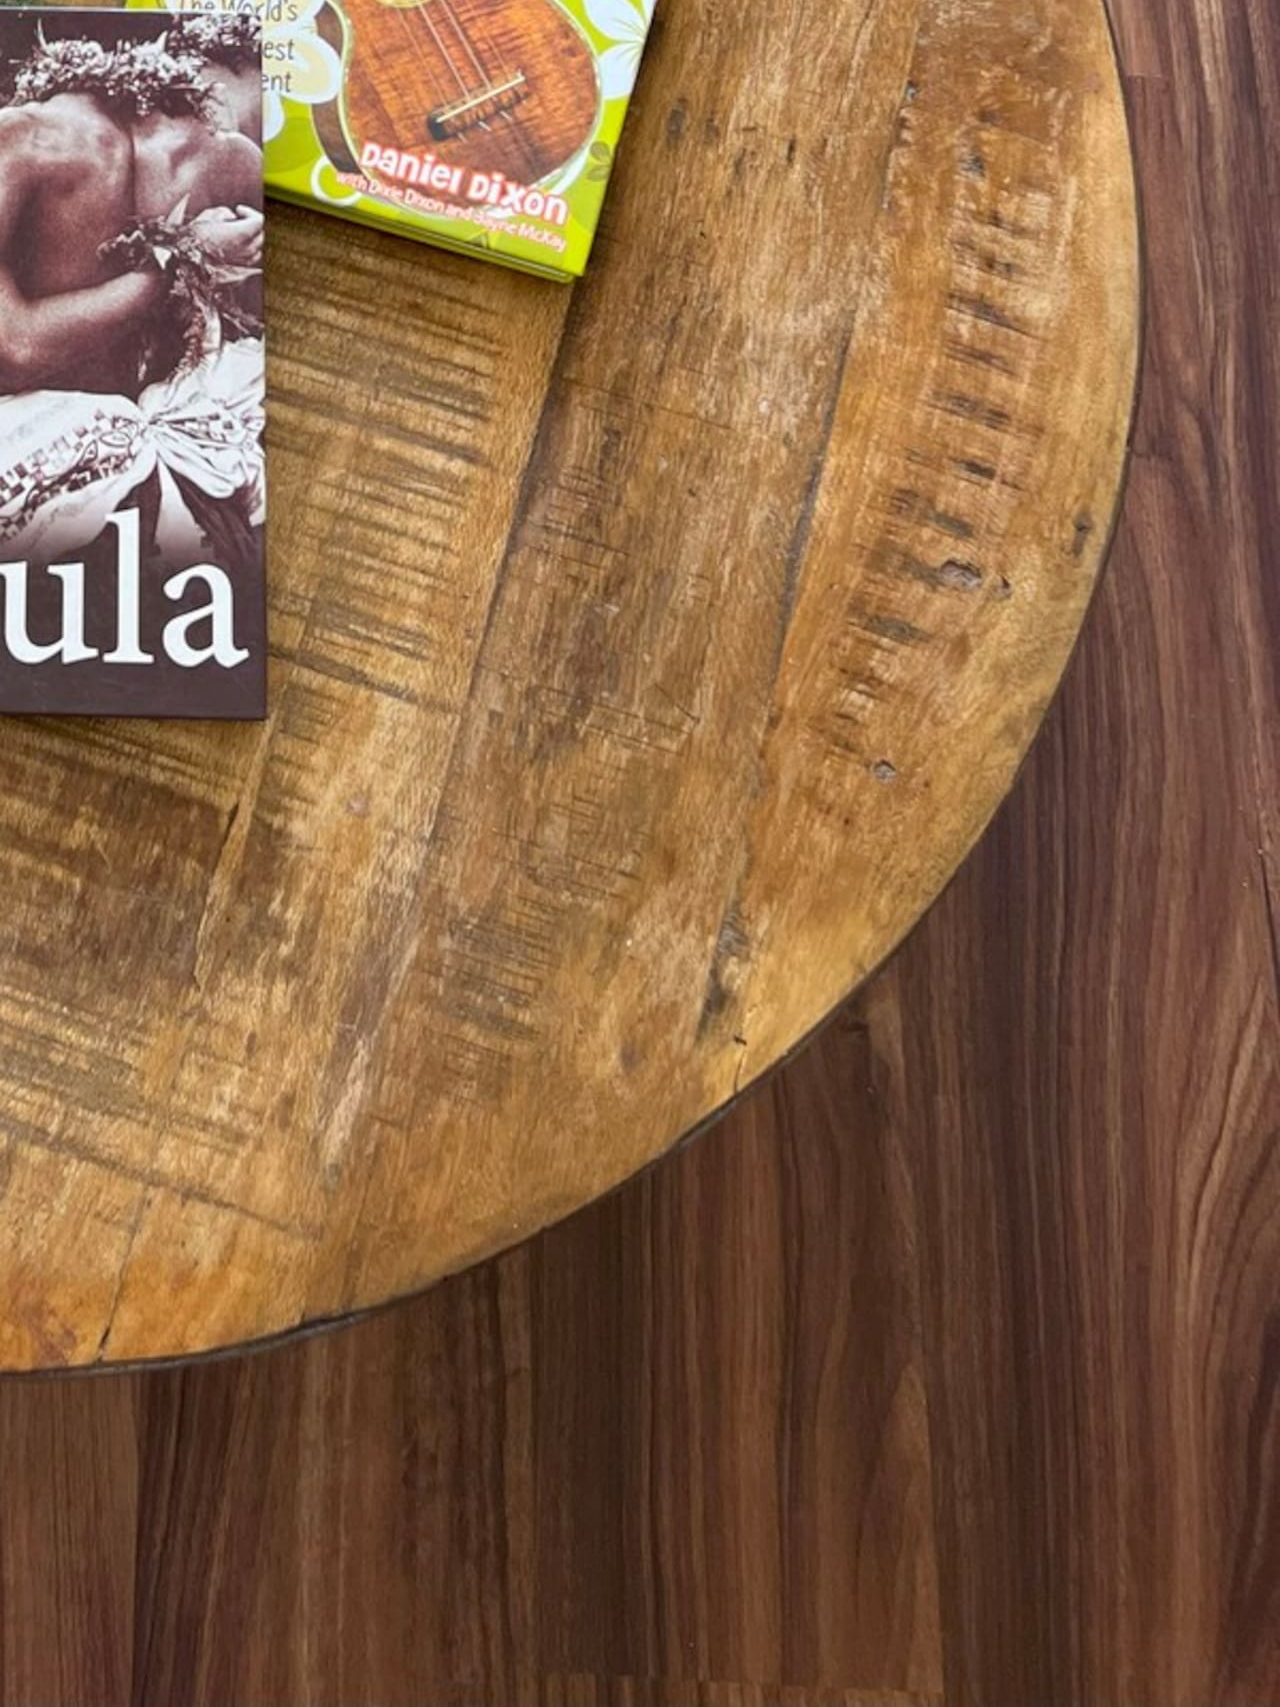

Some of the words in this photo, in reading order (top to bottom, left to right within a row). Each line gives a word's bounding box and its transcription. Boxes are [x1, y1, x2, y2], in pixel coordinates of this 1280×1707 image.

[336, 172, 368, 192] with
[404, 188, 445, 212] Dixon
[445, 203, 472, 220] and
[516, 222, 567, 253] McKay
